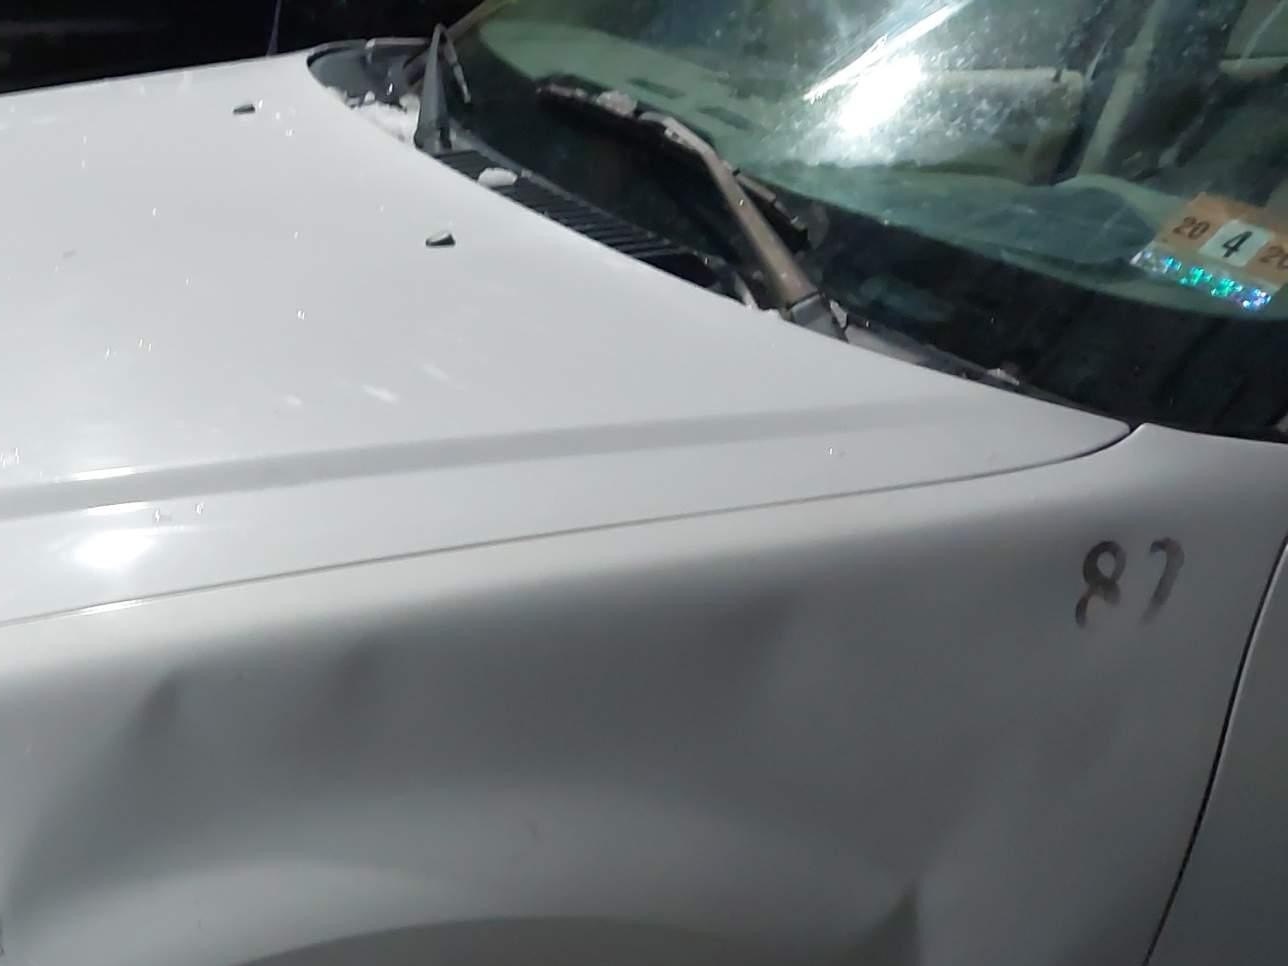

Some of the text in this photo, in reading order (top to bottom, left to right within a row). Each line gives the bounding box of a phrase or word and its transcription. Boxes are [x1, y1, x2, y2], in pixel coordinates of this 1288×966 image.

[1172, 216, 1211, 240] 20
[1222, 231, 1254, 258] 4
[1075, 537, 1185, 629] 87
